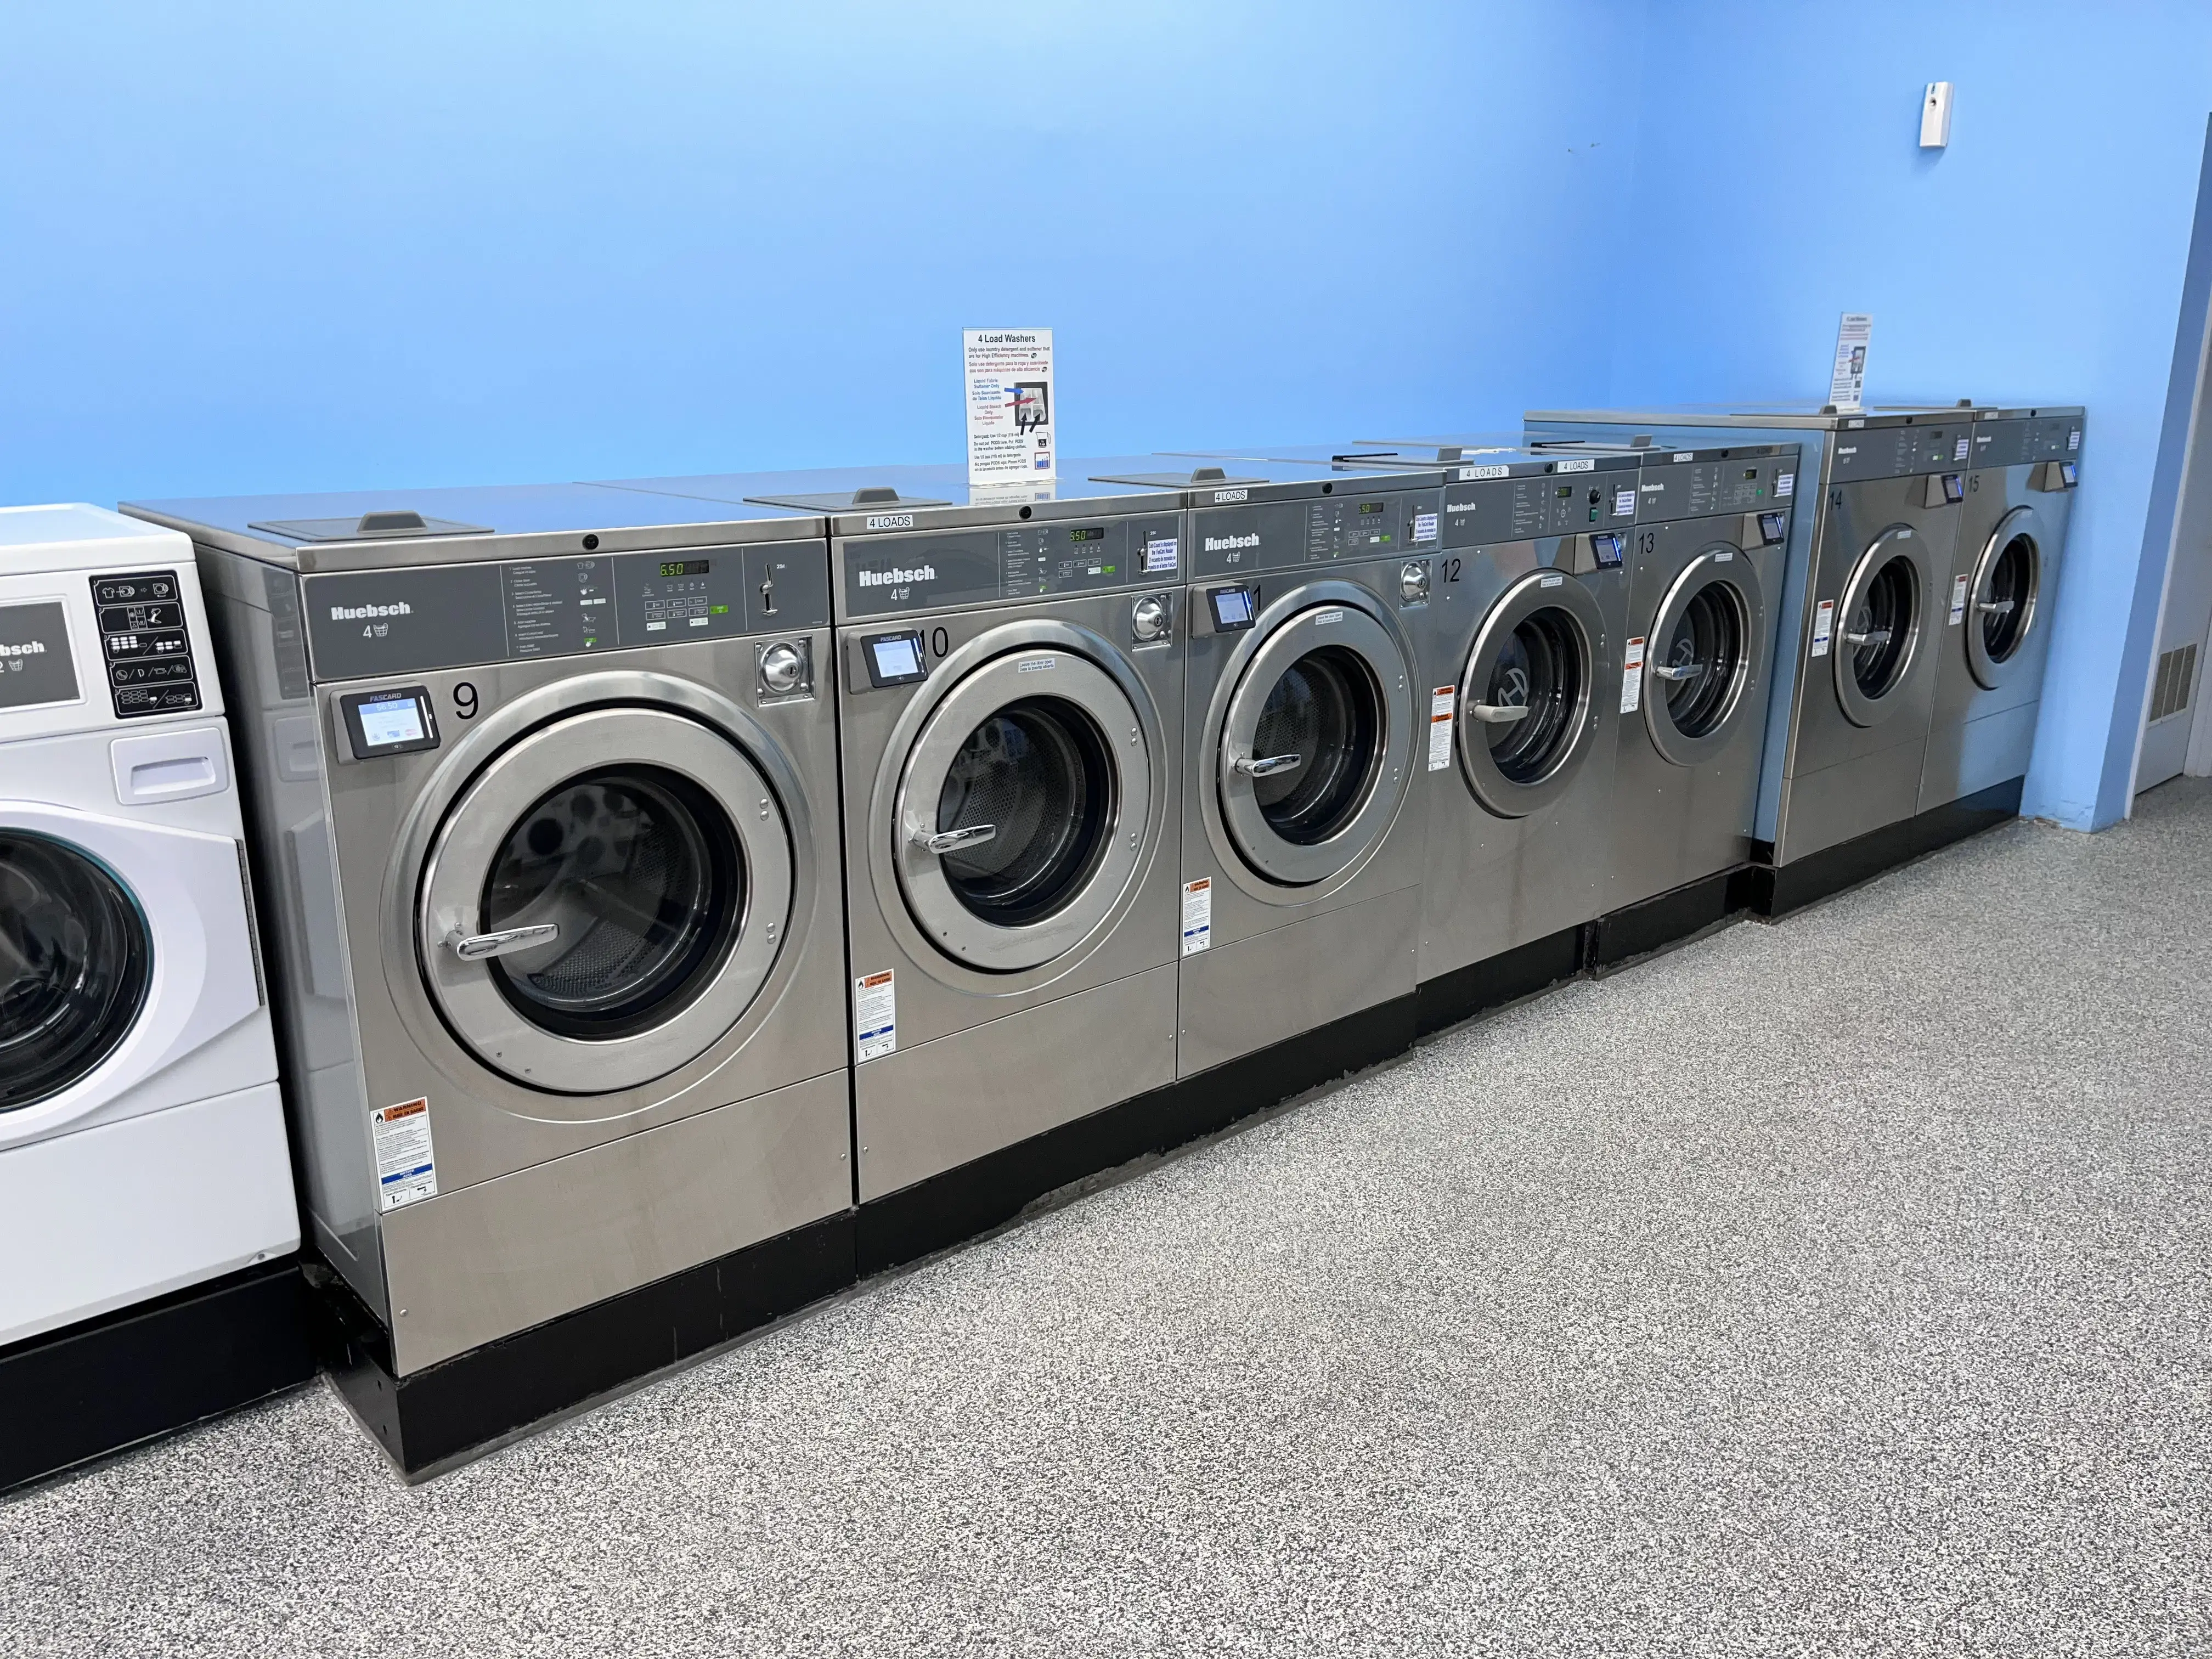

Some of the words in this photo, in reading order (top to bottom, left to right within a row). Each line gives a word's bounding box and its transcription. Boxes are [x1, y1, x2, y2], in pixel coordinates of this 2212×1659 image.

[1005, 334, 1036, 342] Washers
[1475, 468, 1502, 476] LOADS
[1969, 475, 1980, 493] 15
[1222, 491, 1245, 500] LOADS
[1830, 490, 1842, 510] 14
[1447, 503, 1475, 512] Huebsch
[870, 519, 875, 528] 4
[878, 516, 910, 527] LOADS
[1205, 533, 1259, 551] Huebsch
[1639, 532, 1654, 554] 13
[1226, 553, 1232, 563] 4
[661, 563, 684, 576] 6.50
[859, 565, 935, 586] Huebsch
[1442, 558, 1461, 583] 12
[891, 589, 898, 601] 4
[331, 602, 411, 620] Huebsch
[363, 625, 372, 639] 4
[370, 693, 402, 702] FASCARD
[453, 682, 478, 719] 9
[393, 1101, 421, 1111] WARNING
